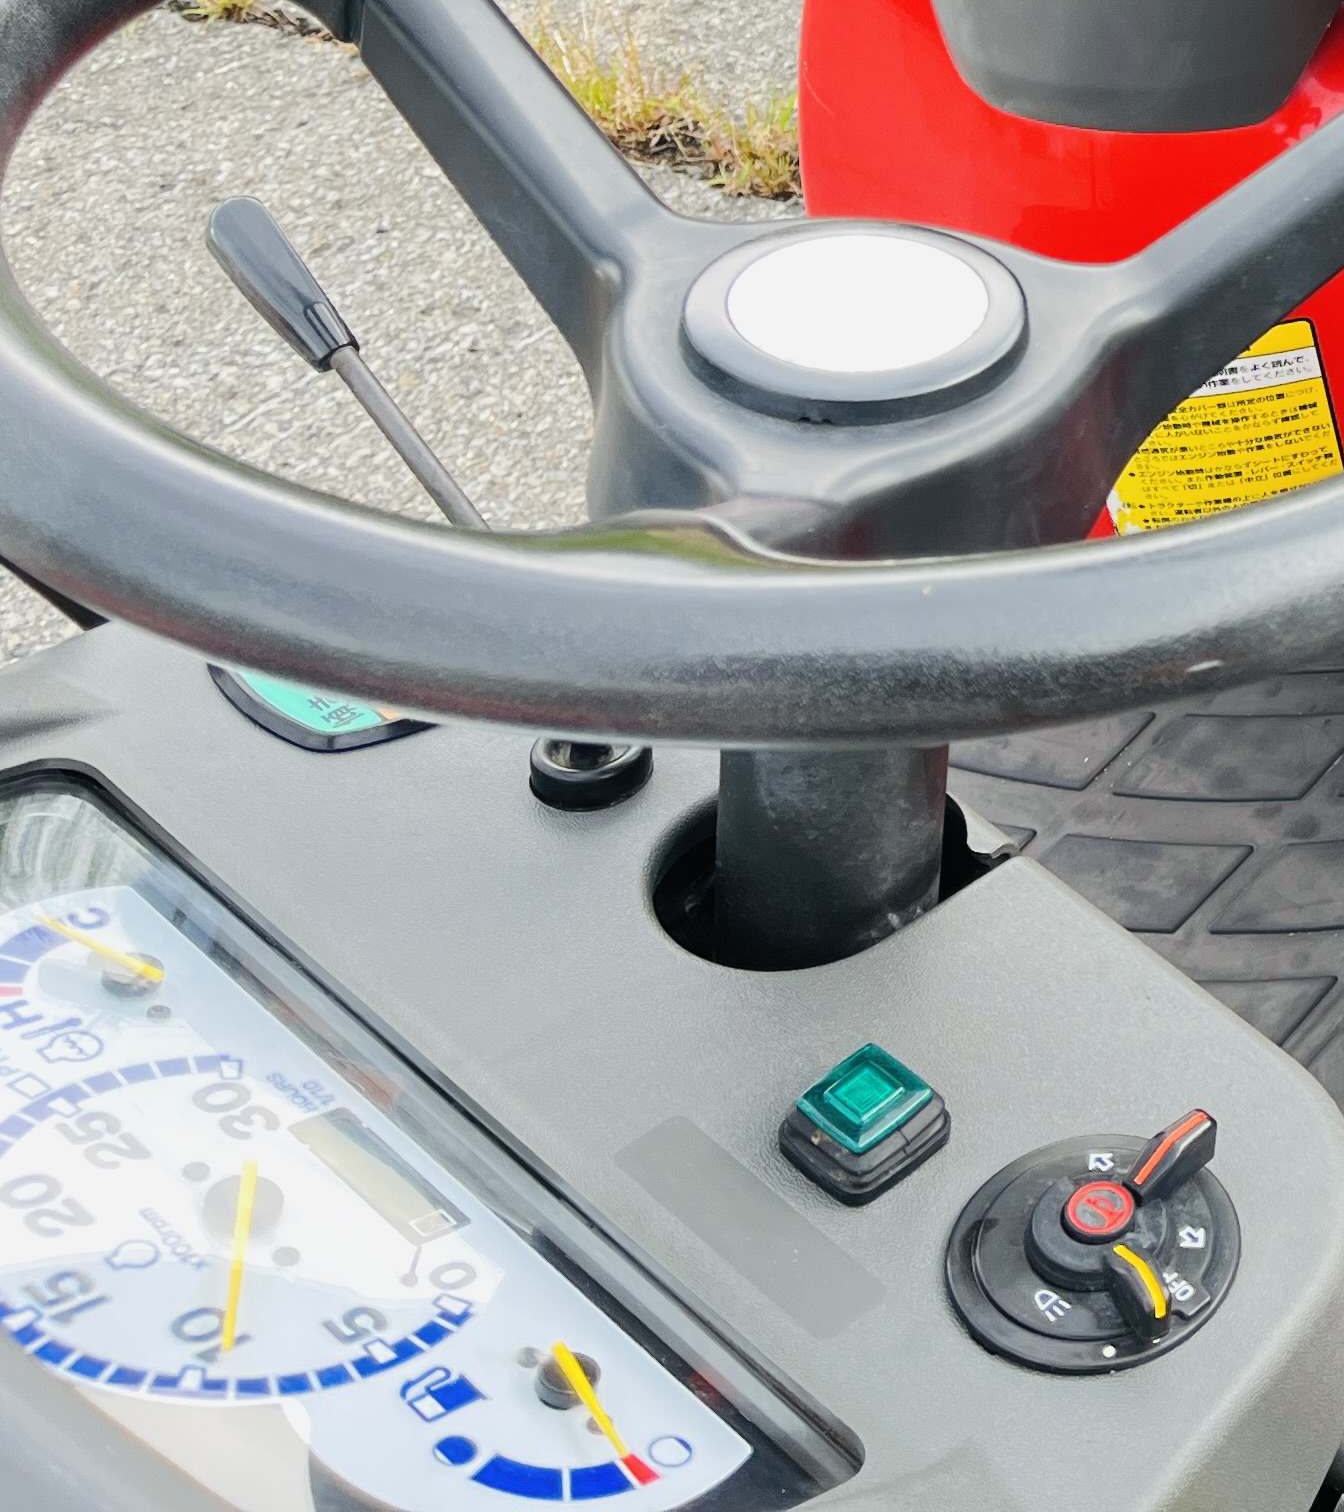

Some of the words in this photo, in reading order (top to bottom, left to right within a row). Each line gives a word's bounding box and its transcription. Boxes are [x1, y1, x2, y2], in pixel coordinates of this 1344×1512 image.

[67, 907, 111, 930] C
[0, 999, 43, 1030] H
[191, 1081, 281, 1140] 30
[266, 1070, 319, 1114] HOURS
[53, 1111, 152, 1170] 25
[0, 1174, 96, 1239] 20
[20, 1270, 111, 1325] 15
[428, 1261, 477, 1291] 0
[170, 1306, 253, 1363] 10
[321, 1306, 388, 1344] 5
